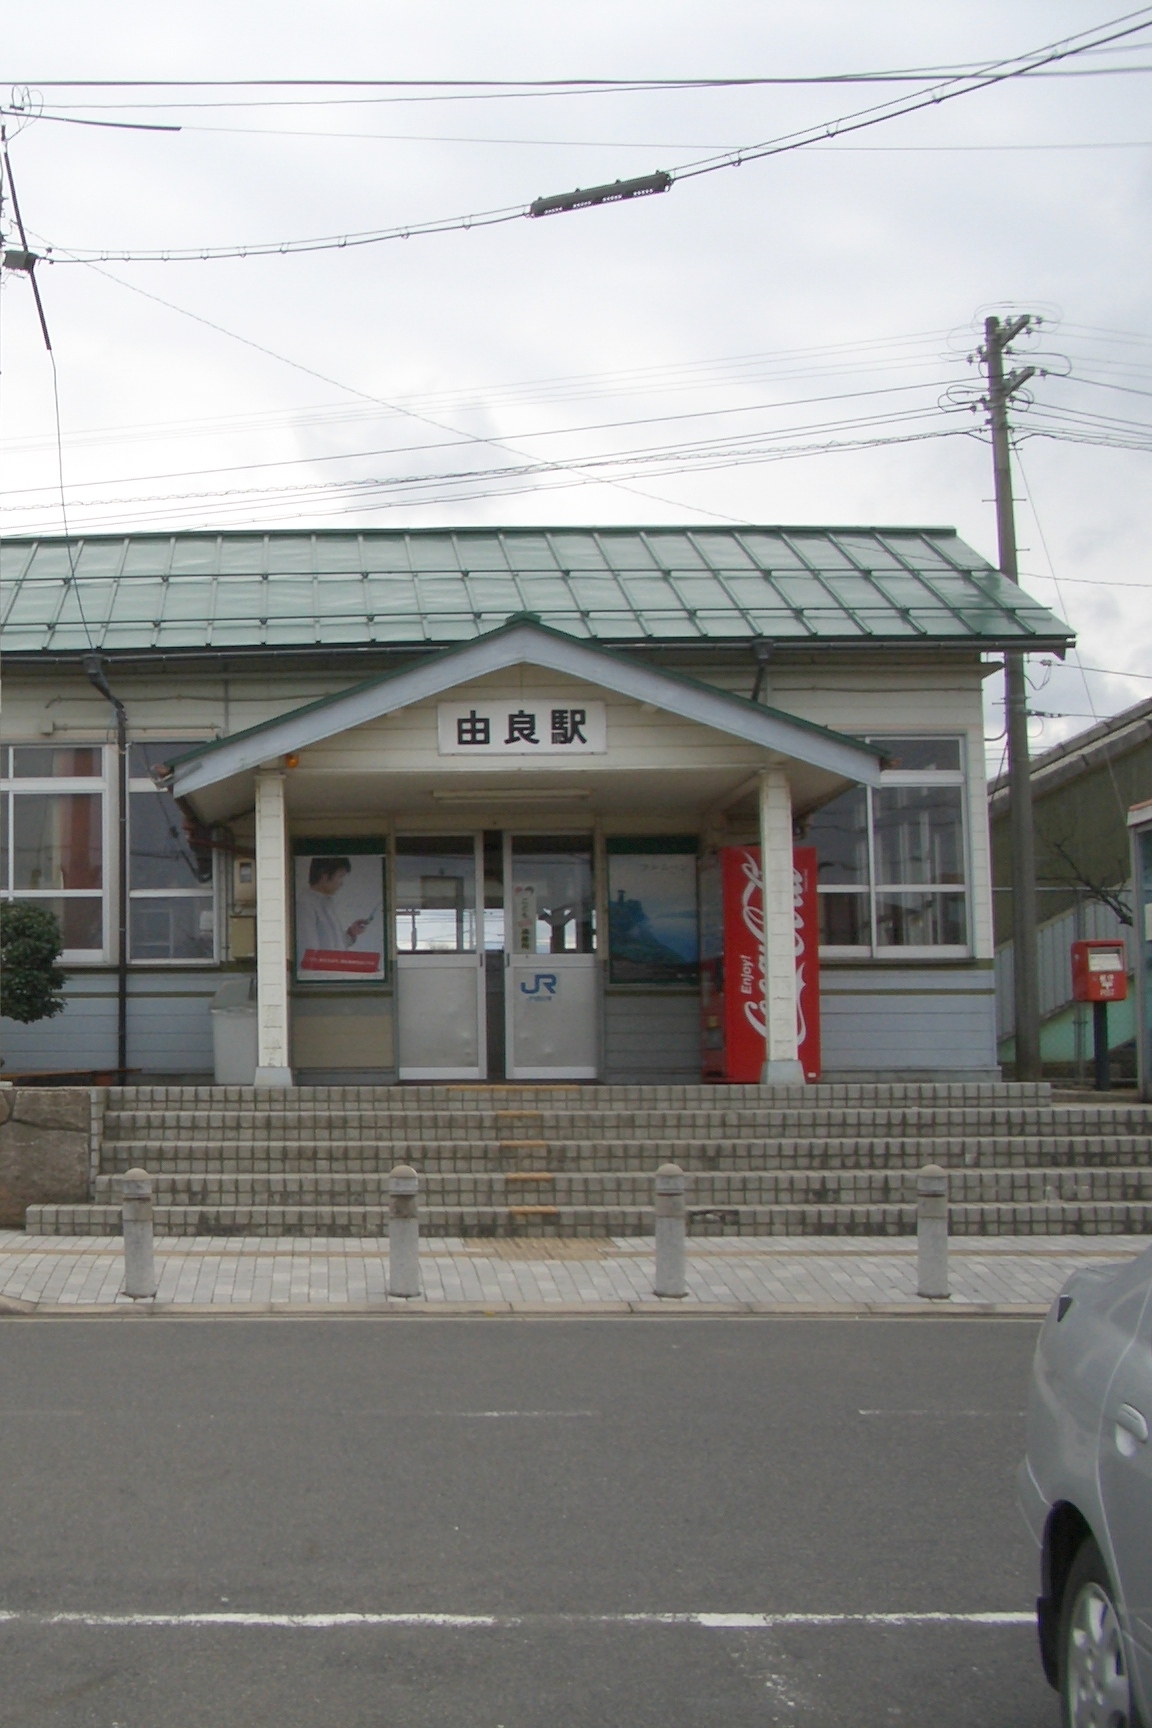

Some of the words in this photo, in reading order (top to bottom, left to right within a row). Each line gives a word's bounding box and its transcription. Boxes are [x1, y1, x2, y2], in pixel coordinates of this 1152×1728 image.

[457, 709, 587, 745] 由良駅
[520, 974, 557, 994] JR
[740, 954, 754, 995] Enjoy!
